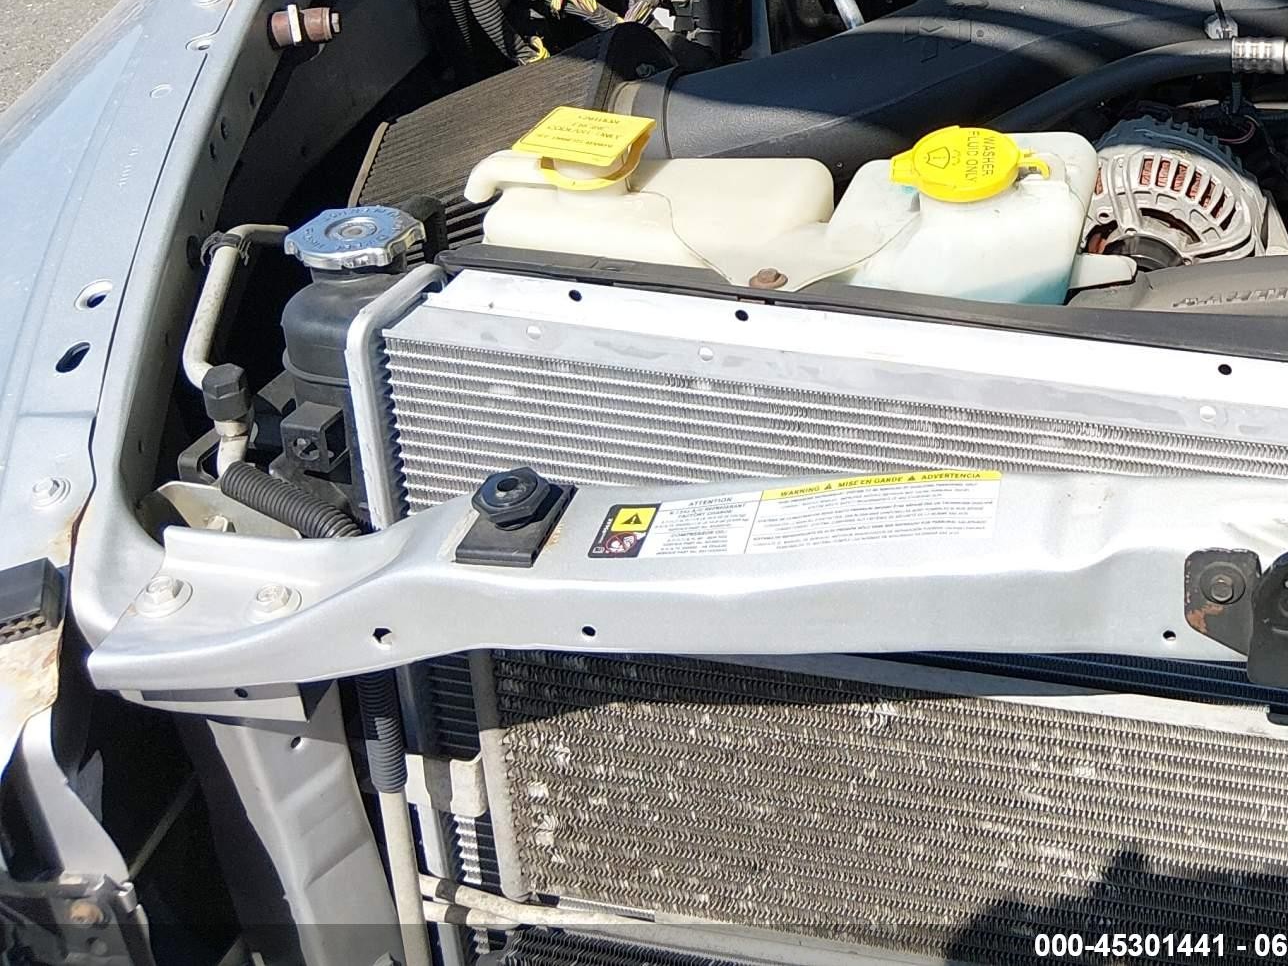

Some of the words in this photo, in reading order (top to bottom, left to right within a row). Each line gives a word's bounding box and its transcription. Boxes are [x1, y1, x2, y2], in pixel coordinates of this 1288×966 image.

[967, 130, 981, 160] FLUID
[982, 136, 997, 177] WASHER
[965, 159, 980, 183] ONLY
[779, 485, 820, 497] WARNING
[838, 479, 859, 488] MISE
[859, 478, 873, 486] EN
[874, 476, 904, 485] GARDE
[920, 472, 981, 481] ADVERTENCIA
[688, 496, 733, 507] ATTENTION
